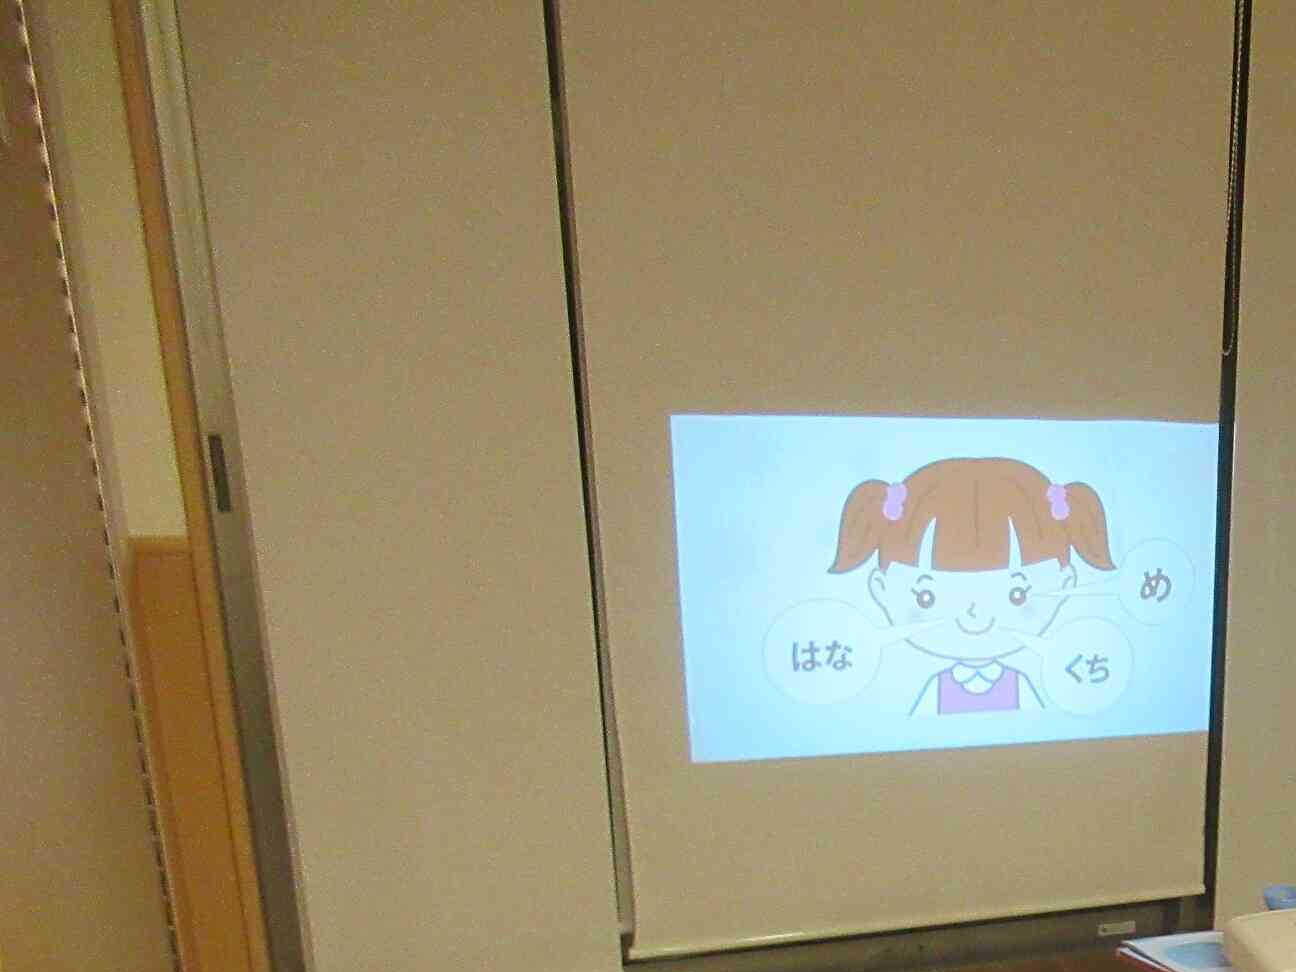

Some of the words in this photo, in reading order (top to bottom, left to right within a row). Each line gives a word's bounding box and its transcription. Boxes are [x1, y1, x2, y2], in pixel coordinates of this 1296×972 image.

[1140, 568, 1172, 602] め
[792, 639, 854, 672] はな
[1065, 653, 1110, 684] くち
